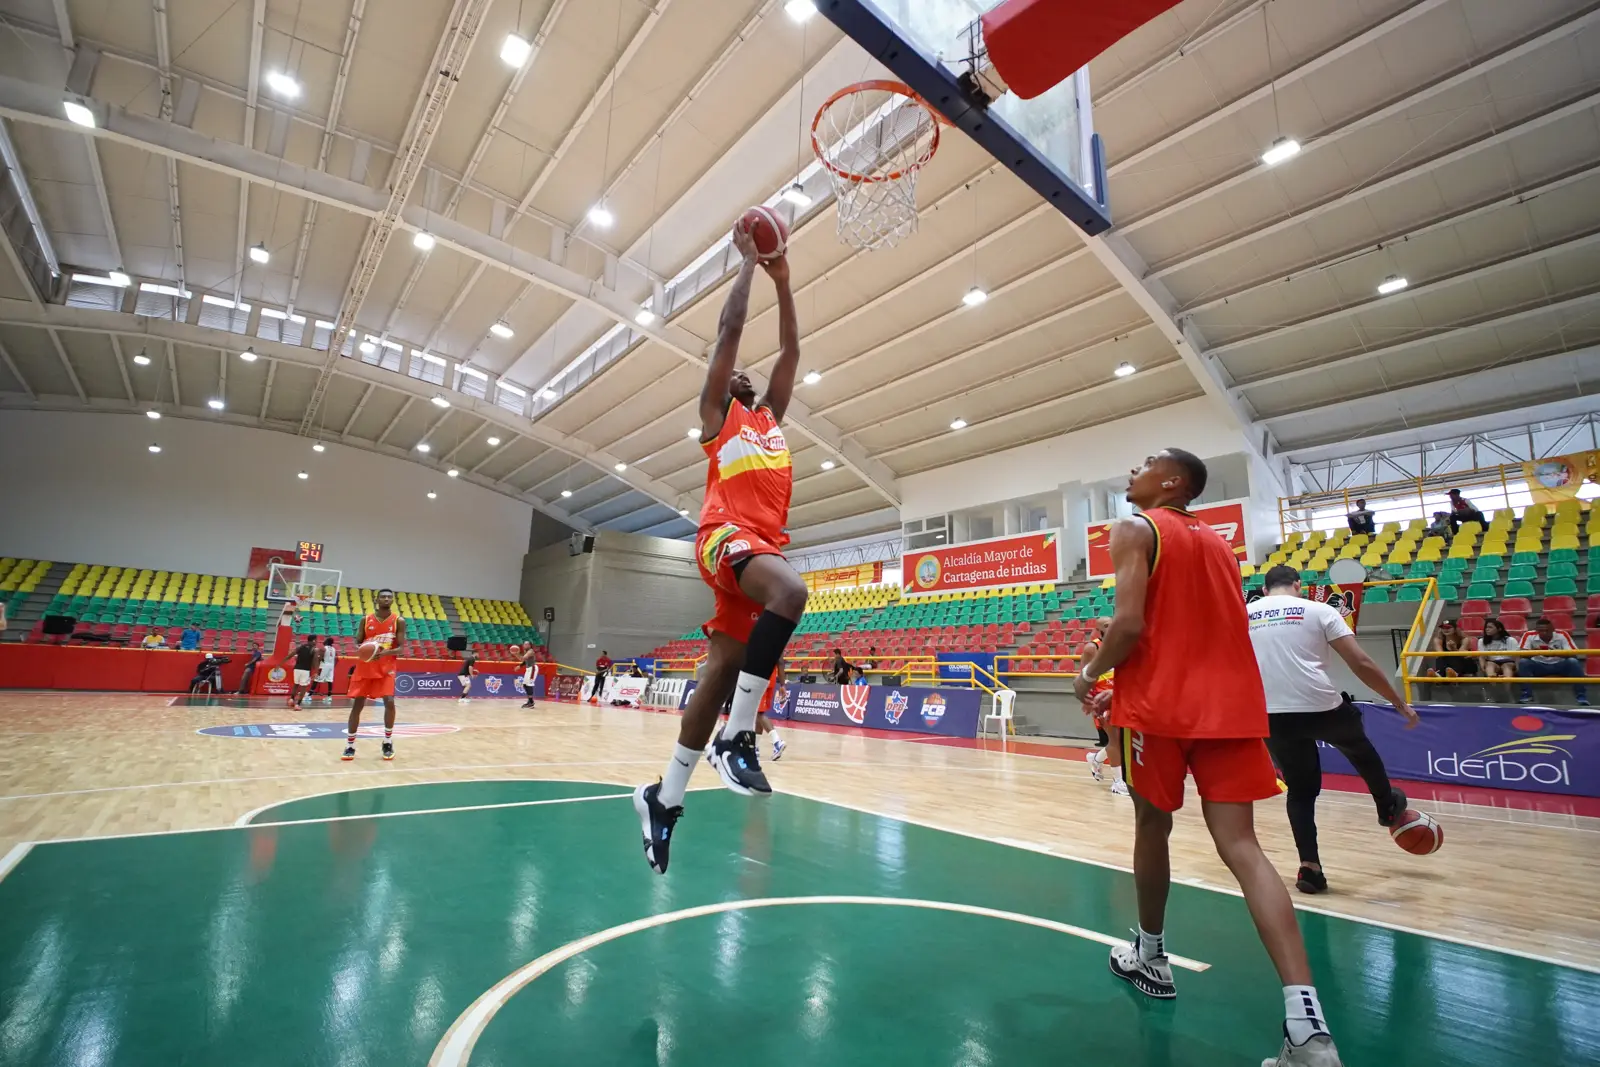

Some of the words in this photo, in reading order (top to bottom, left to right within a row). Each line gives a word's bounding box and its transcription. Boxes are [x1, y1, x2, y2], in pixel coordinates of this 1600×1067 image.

[300, 549, 320, 561] 24
[943, 552, 982, 568] Alcaldía
[984, 550, 1018, 563] Mayor
[1019, 545, 1033, 557] de
[943, 570, 994, 583] Cartagena
[996, 566, 1009, 578] de
[1011, 562, 1047, 576] indias
[1248, 611, 1262, 621] MOS
[1264, 609, 1280, 618] POR
[417, 679, 442, 687] GIGA
[443, 679, 453, 687] IT
[798, 691, 811, 699] LIGA
[804, 699, 839, 709] BALONCESTO
[920, 704, 946, 716] FCB
[794, 706, 831, 717] PROFESIONAL
